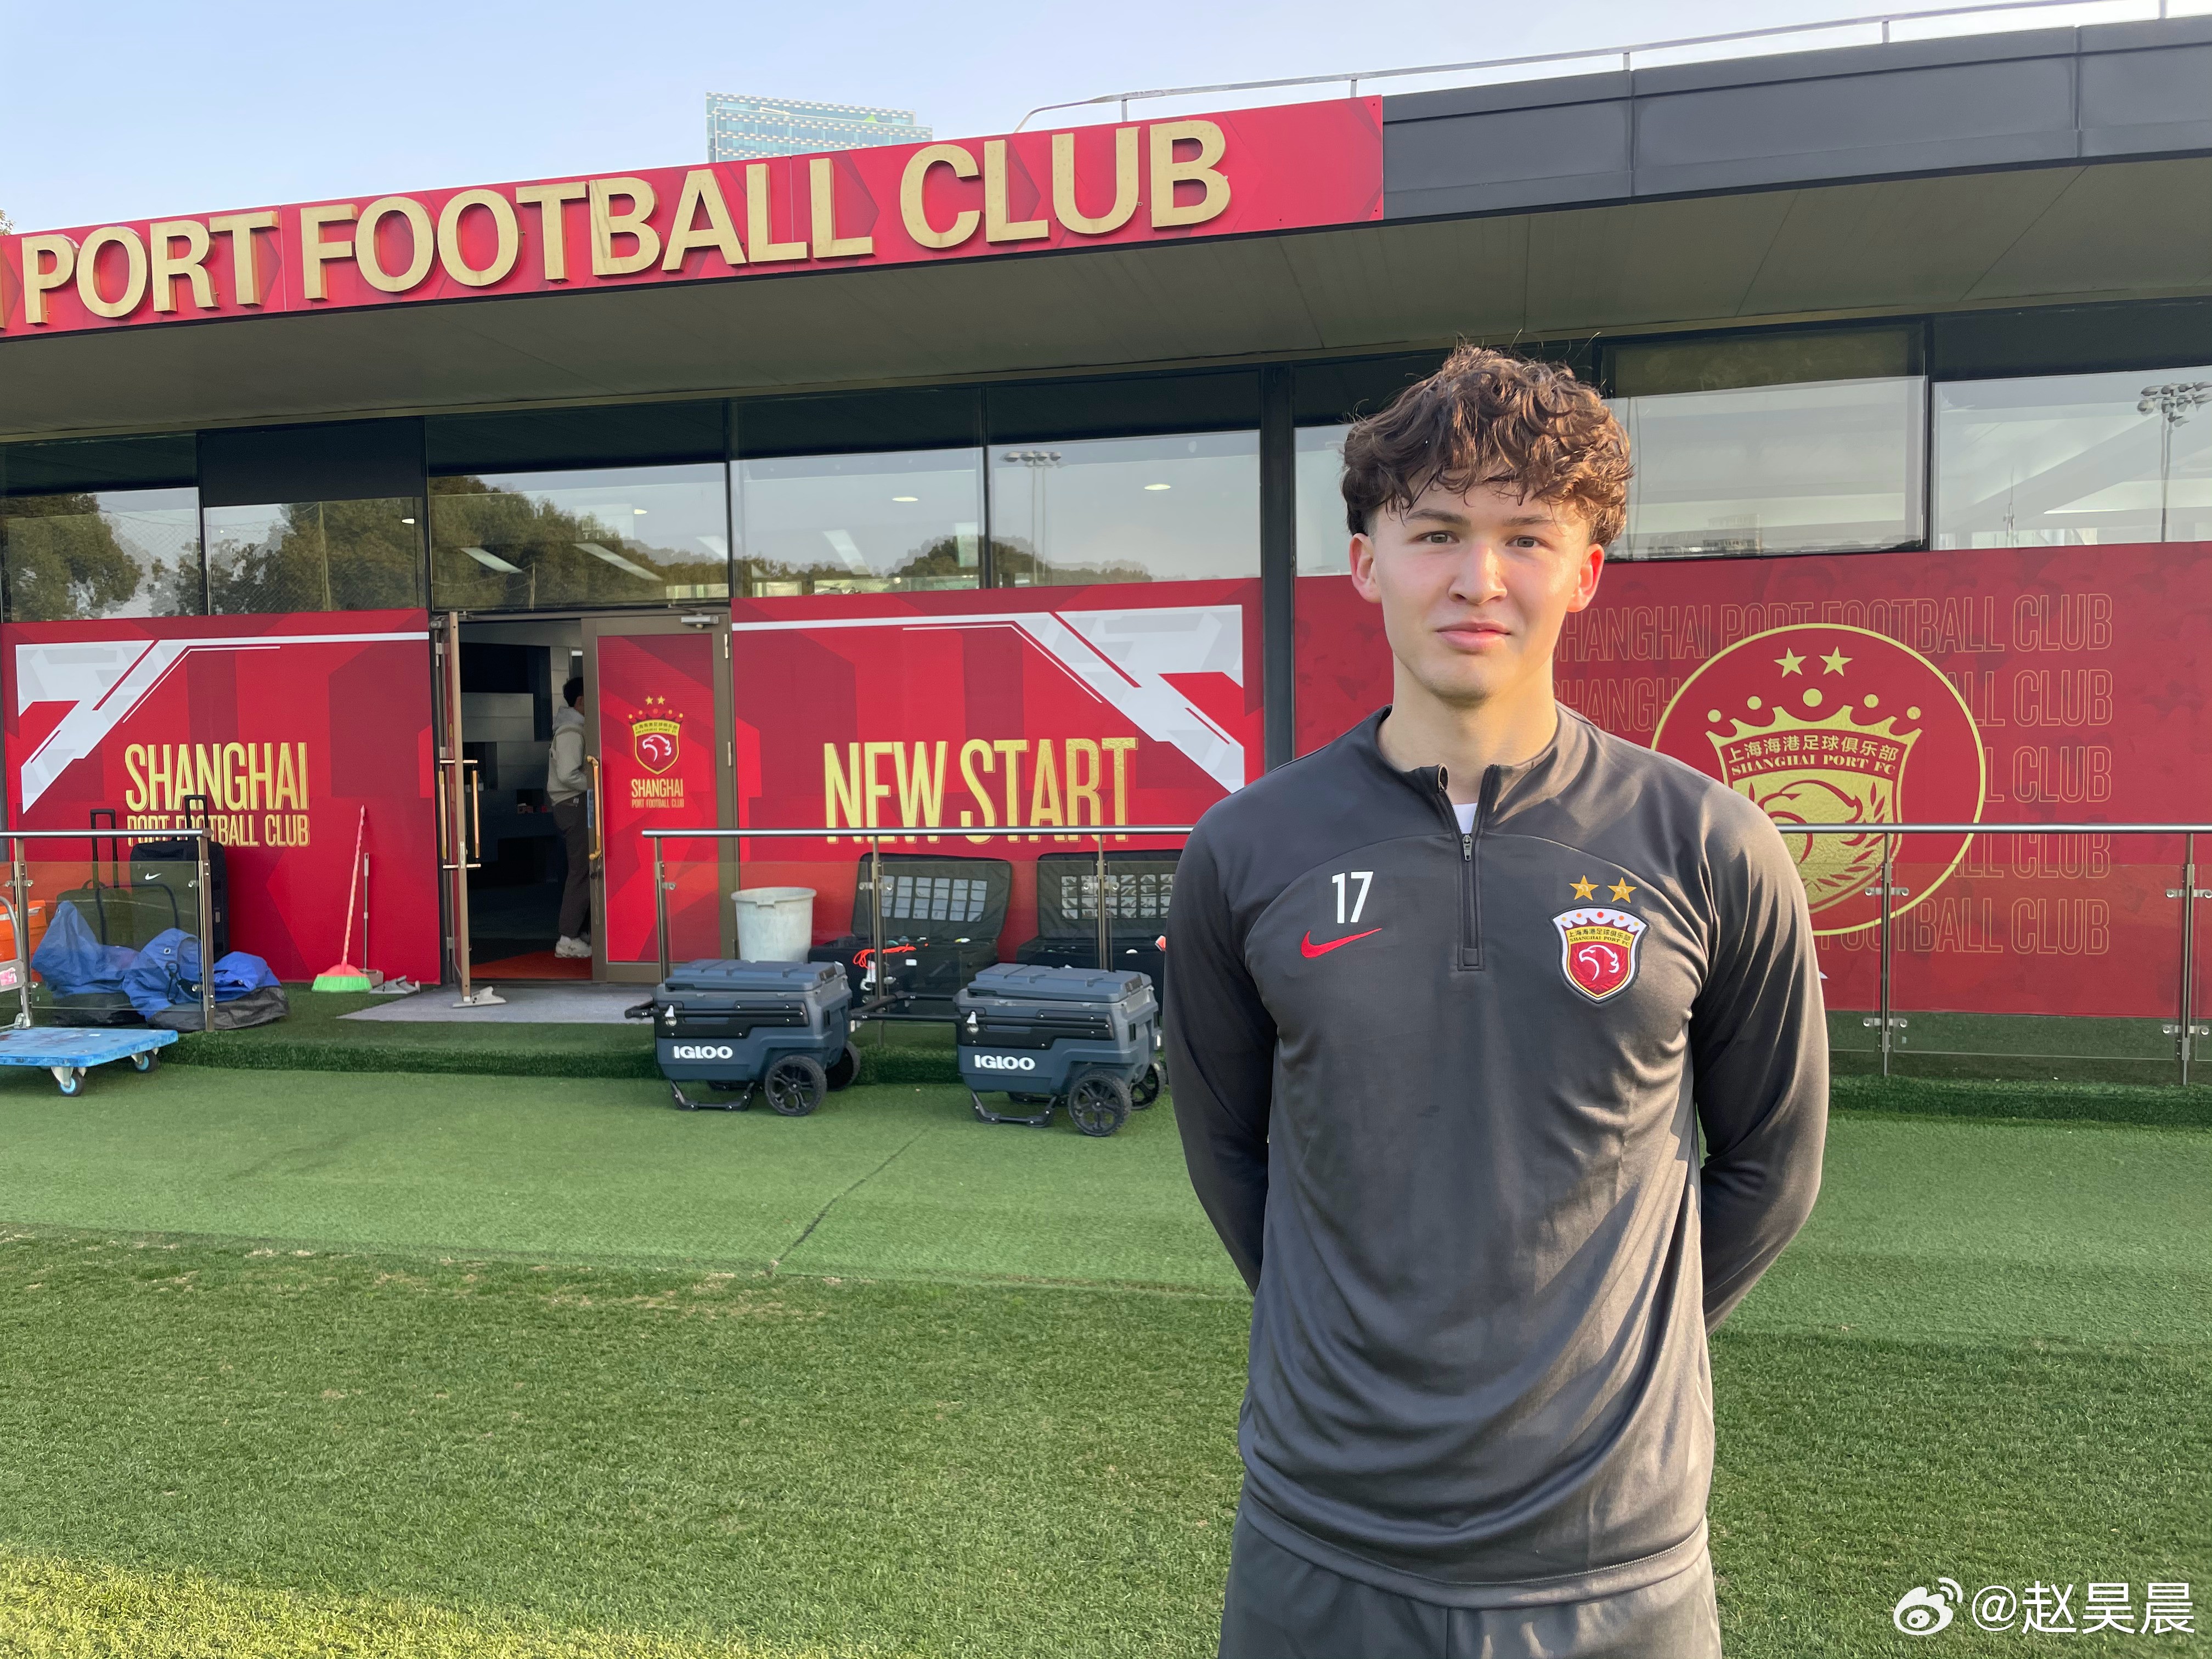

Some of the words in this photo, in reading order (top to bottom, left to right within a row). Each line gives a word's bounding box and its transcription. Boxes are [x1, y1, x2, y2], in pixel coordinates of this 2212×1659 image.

[21, 211, 279, 325] PORT
[300, 158, 875, 300] FOOTBALL
[900, 120, 1233, 249] CLUB
[2013, 594, 2113, 652] CLUB
[2013, 669, 2113, 726] CLUB
[125, 742, 309, 811] SHANGHAI
[1728, 734, 1900, 764] 上海海港足球俱乐部
[1731, 754, 1816, 776] SHANGHAI
[1822, 754, 1870, 769] PORT
[1874, 761, 1896, 775] FC
[2012, 746, 2112, 803] CLUB
[631, 778, 684, 798] SHANGHAI
[823, 740, 949, 843] NEW
[960, 737, 1139, 843] START
[264, 814, 311, 847] CLUB
[1331, 871, 1374, 924] 17
[2011, 898, 2109, 955] CLUB
[673, 1045, 733, 1059] IGLOO
[974, 1054, 1036, 1071] IGLOO
